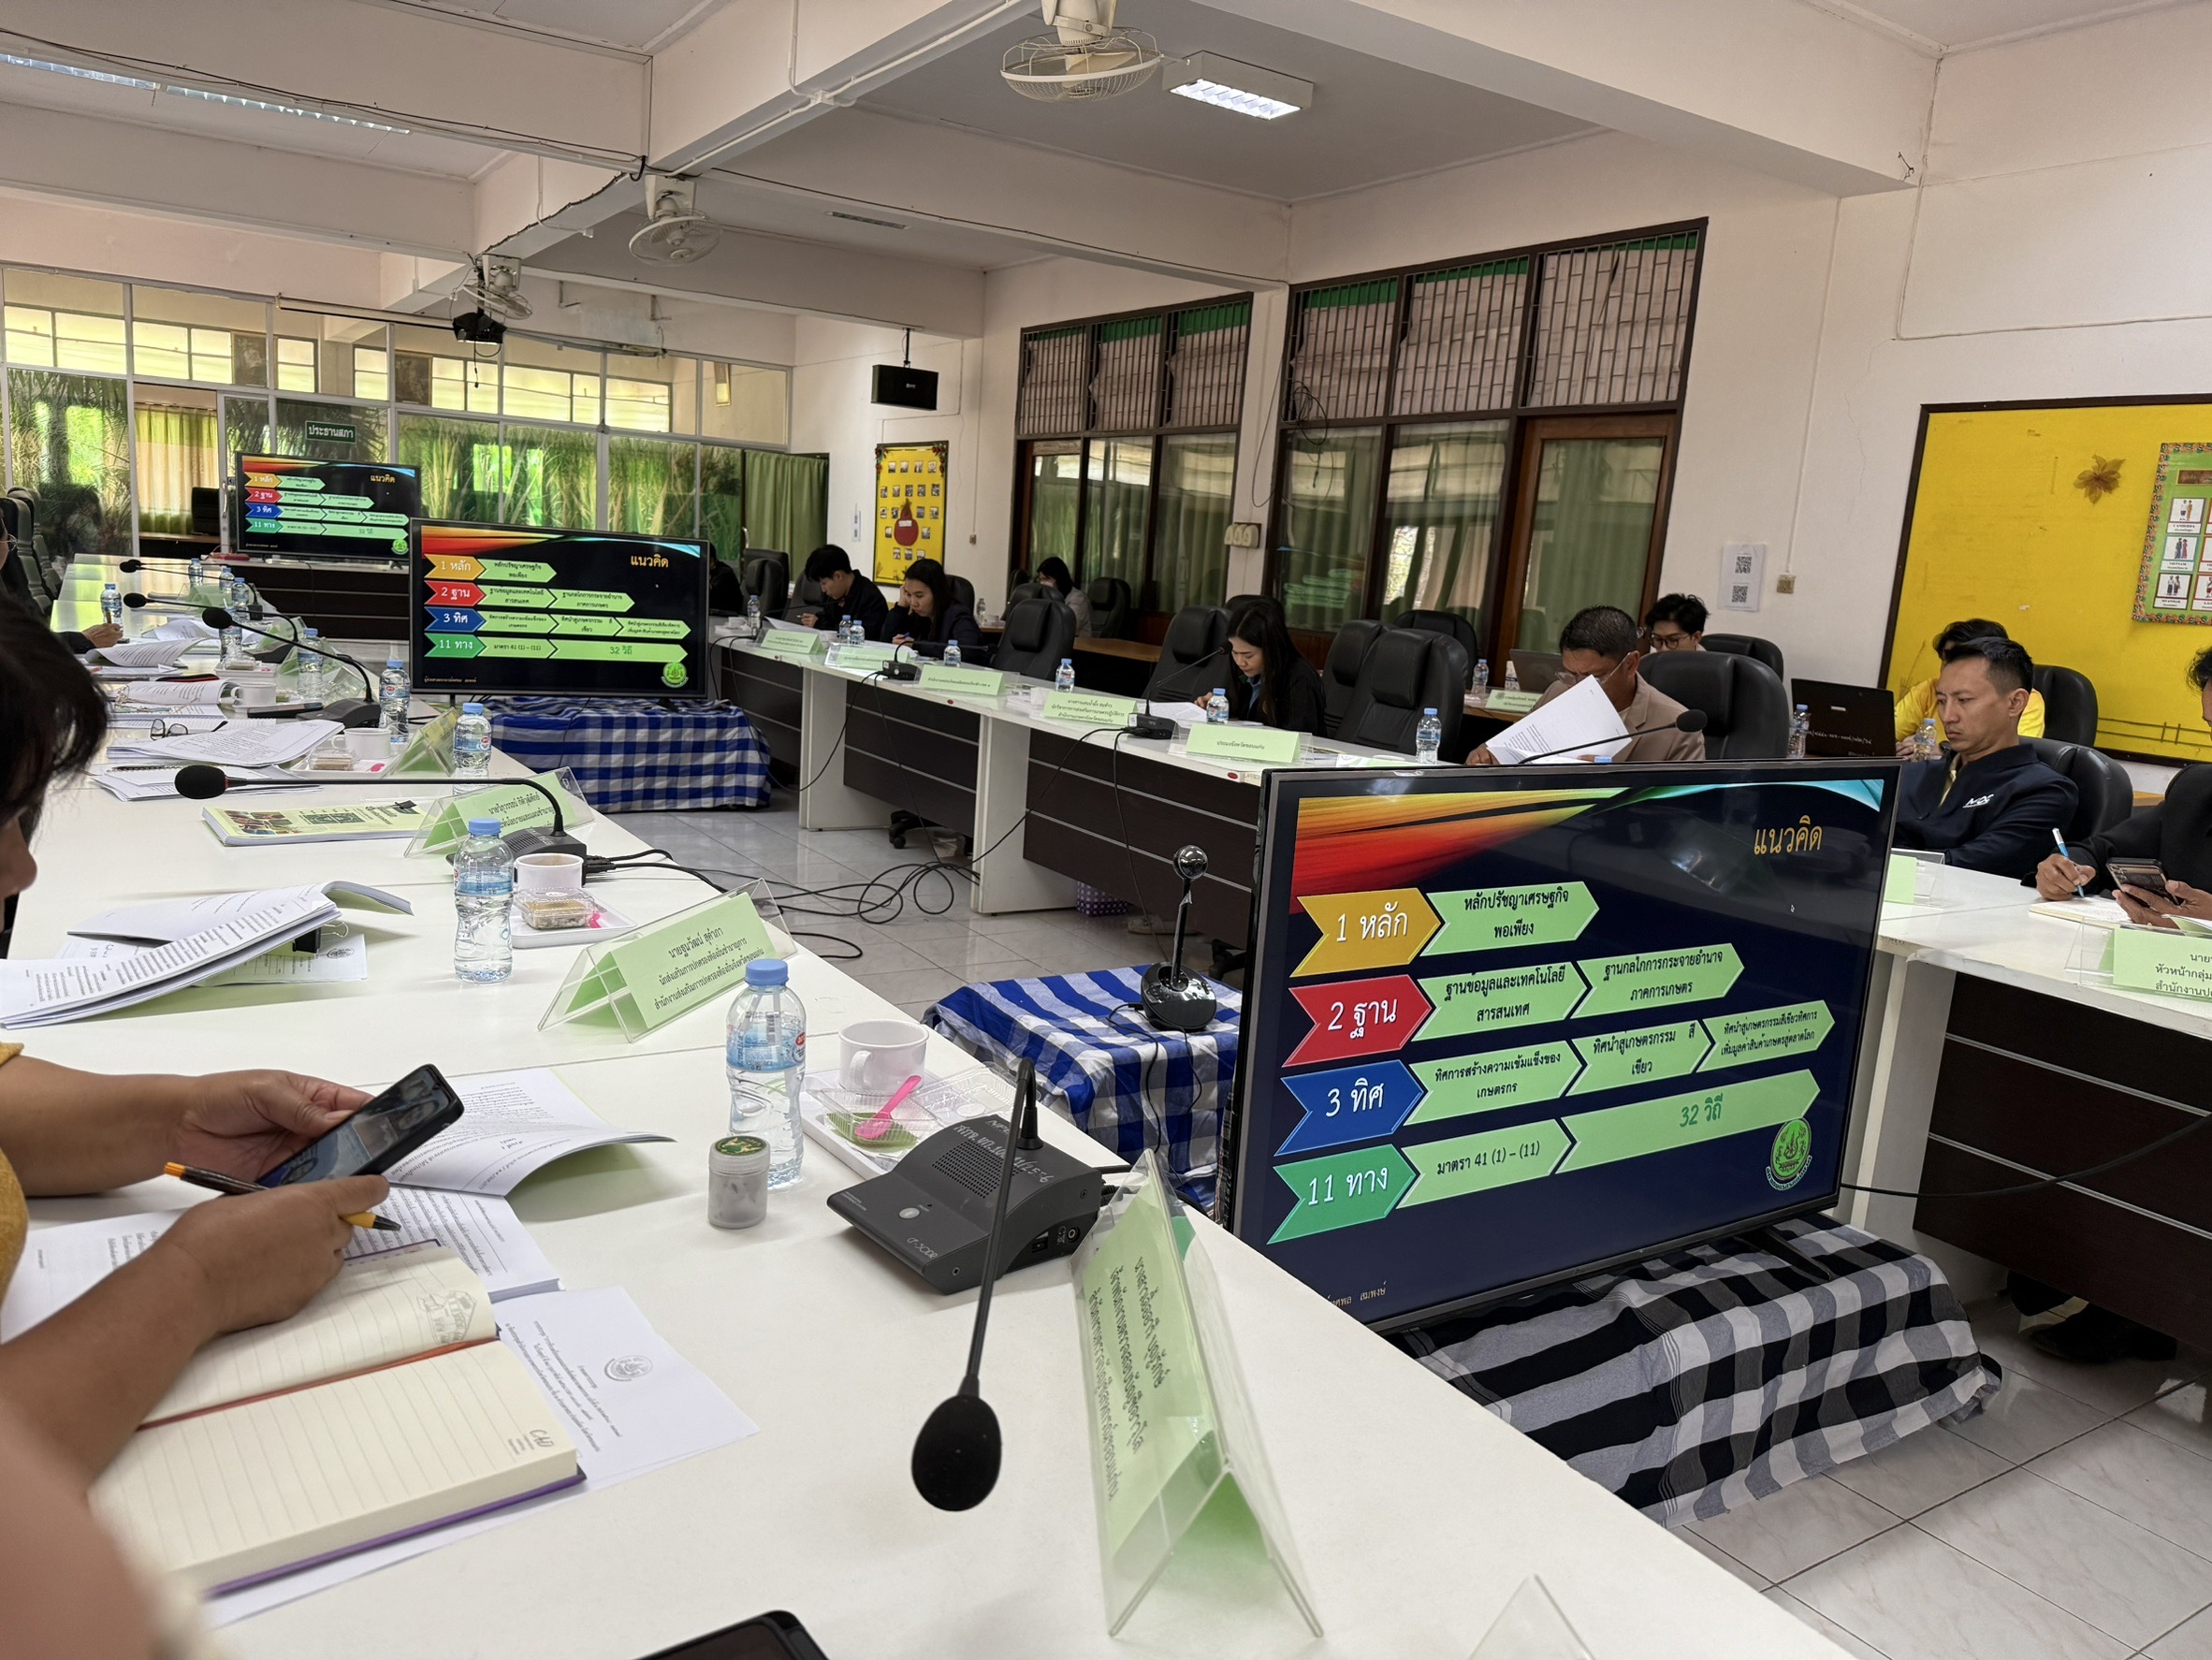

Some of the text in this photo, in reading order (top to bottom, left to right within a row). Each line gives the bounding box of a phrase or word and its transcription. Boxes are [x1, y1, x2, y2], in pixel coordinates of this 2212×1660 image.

[309, 425, 354, 439] ประธานสภา
[441, 559, 471, 572] 1 หลัก
[631, 553, 669, 568] แนวคิด
[441, 587, 471, 600] 2 ฐาน
[443, 610, 469, 624] 3 ทิศ
[439, 639, 474, 650] 11 ทาง
[609, 646, 619, 655] 32
[1754, 814, 1823, 855] แนวคิด
[1463, 888, 1569, 911] หลักปรัชญาเศรษฐกิจ
[1336, 901, 1409, 942] 1 หลัก
[1493, 918, 1535, 939] พอเพียง
[1603, 948, 1723, 983] ฐานกลไกการกระจายอำนาจ
[1630, 982, 1694, 1002] ภาคการเกษตร
[1327, 997, 1397, 1039] 2 ฐาน
[1477, 1002, 1530, 1023] สารสนเทศ
[1434, 1050, 1561, 1082] ทิศการสร้างความเข้มแข็งของ
[1631, 1059, 1652, 1075] เขียว
[1325, 1077, 1385, 1117] 3 ทิศ
[1477, 1081, 1518, 1099] เกษตรกร
[1680, 1093, 1724, 1128] 32 วิถี
[1436, 1156, 1471, 1175] มาตรา
[1474, 1151, 1488, 1167] 41
[1491, 1146, 1507, 1166] (1)
[1519, 1140, 1541, 1159] (11)
[1308, 1167, 1389, 1206] 11 ทาง
[1360, 1281, 1387, 1302] สมพงษ์
